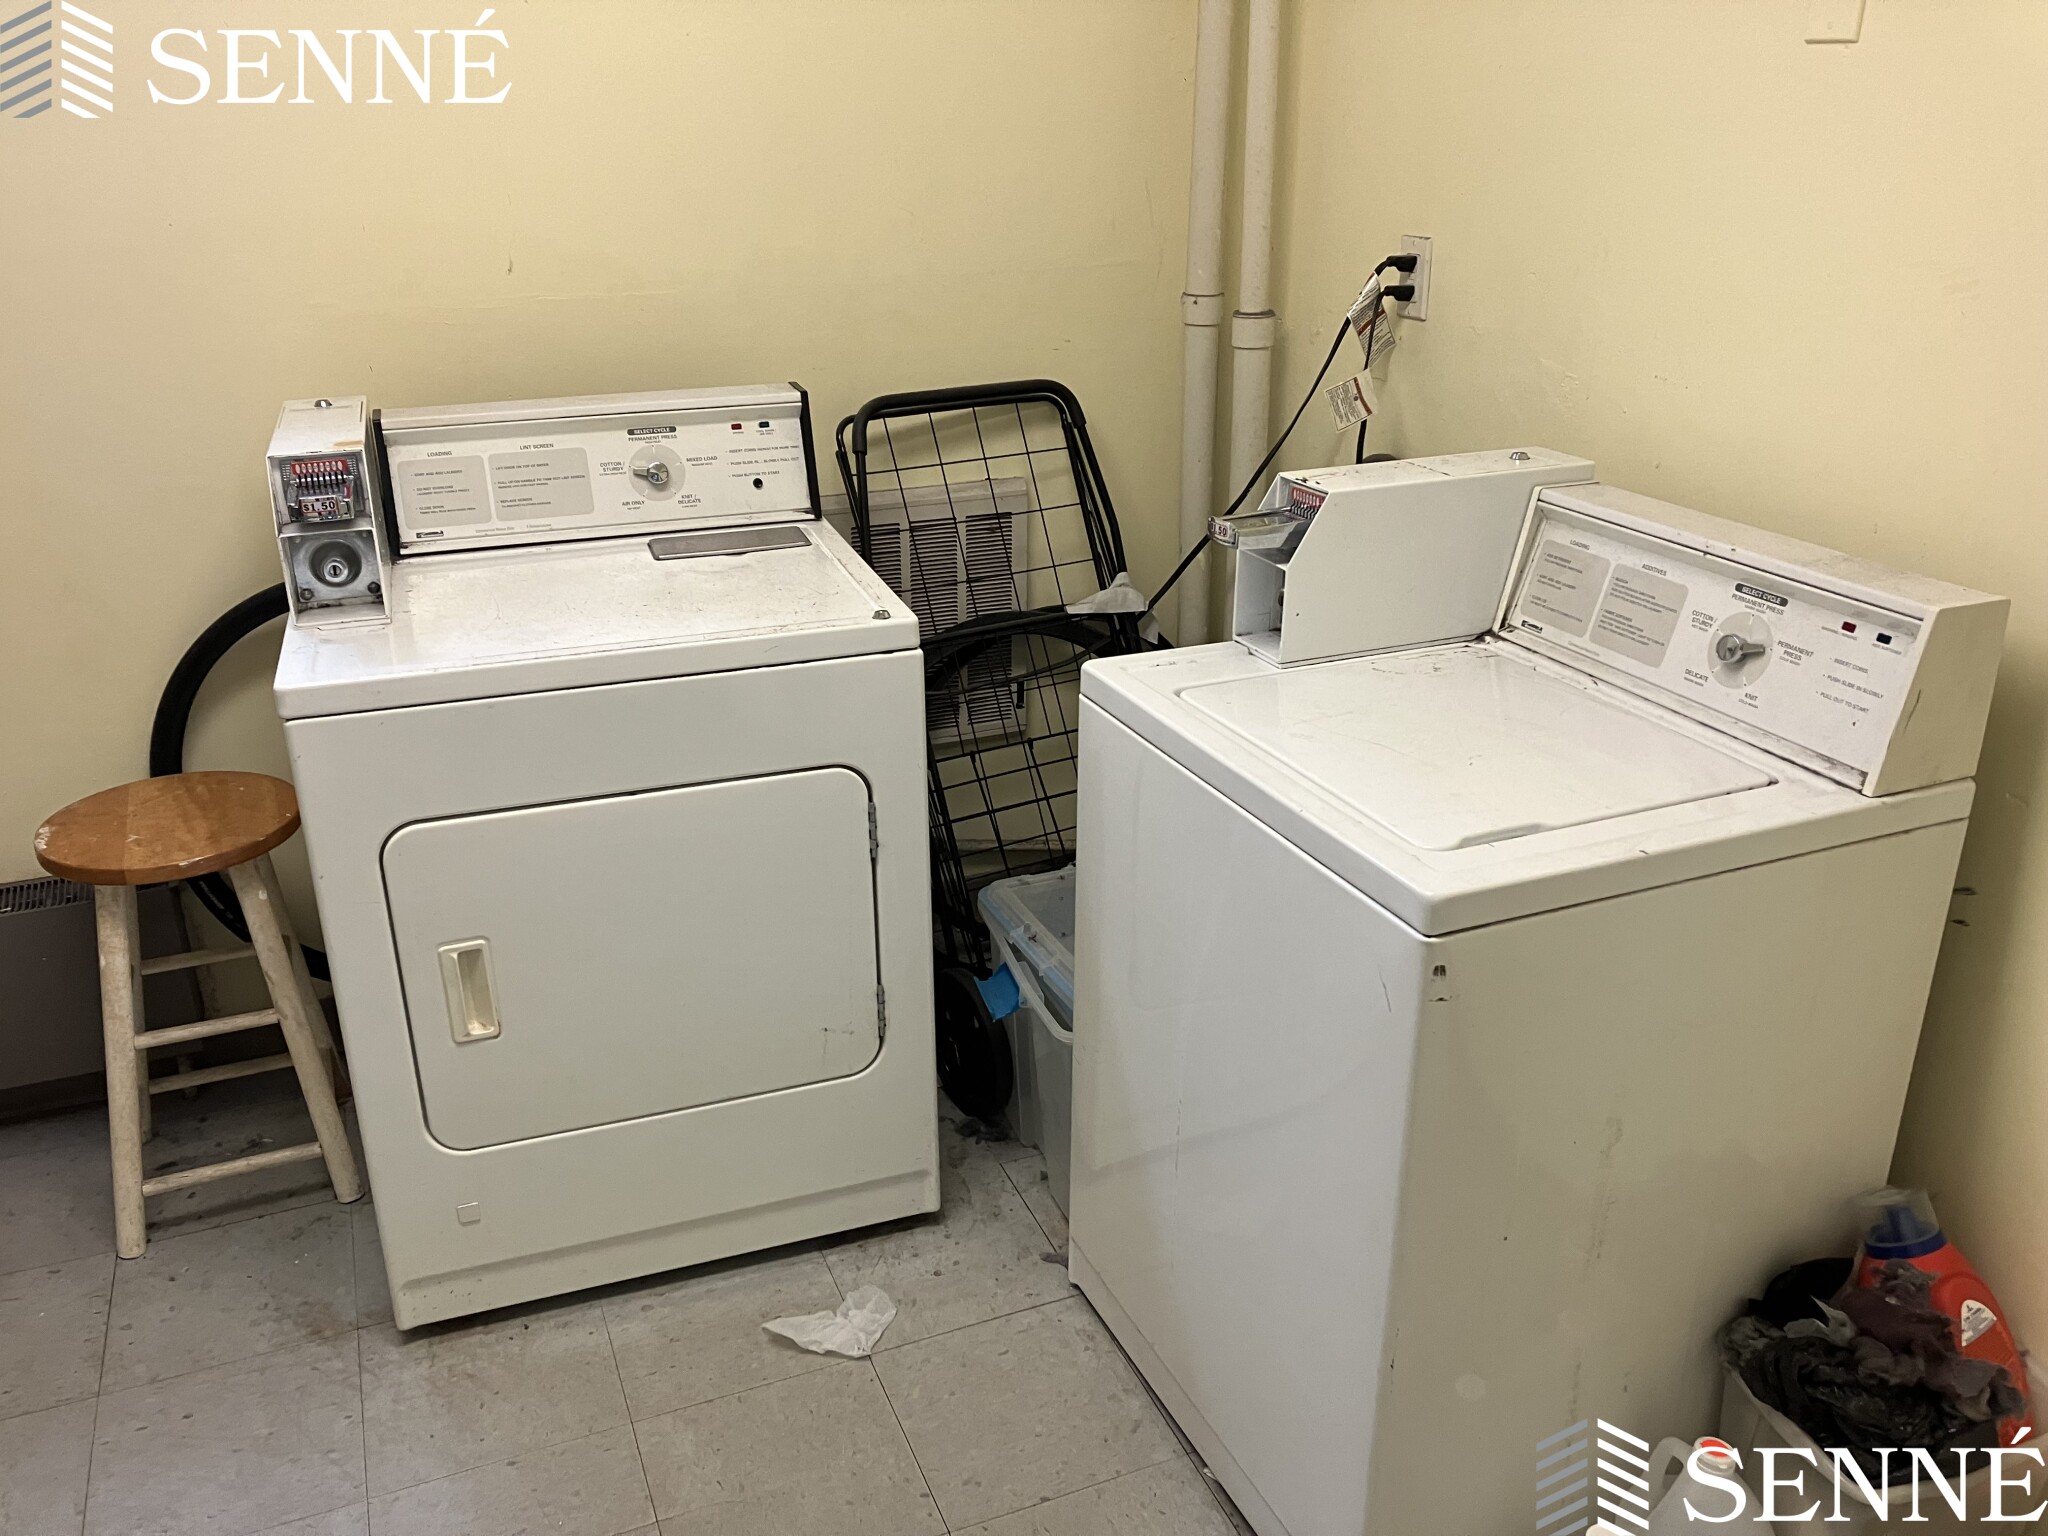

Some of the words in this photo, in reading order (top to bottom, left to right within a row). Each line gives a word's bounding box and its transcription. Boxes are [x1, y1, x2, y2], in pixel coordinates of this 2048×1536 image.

[303, 500, 335, 512] $1.50
[1569, 539, 1590, 550] LOADING
[1641, 563, 1667, 576] ADDITIVES
[1742, 586, 1762, 598] SELECT
[1763, 593, 1781, 604] CYCLE
[1731, 593, 1765, 609] PERMANENT
[1766, 604, 1784, 615] PRESS
[1692, 610, 1715, 622] COTTON
[1691, 617, 1713, 629] STURDY
[1777, 640, 1814, 657] PERMANENT
[1783, 649, 1802, 661] PRESS
[1834, 658, 1852, 668] INSERT
[1685, 668, 1709, 682] DELICATE
[1827, 675, 1841, 684] PUSH
[1842, 680, 1855, 689] SLIDE
[1745, 692, 1758, 701] KNIT
[1820, 691, 1832, 700] PULL
[1853, 704, 1869, 713] START
